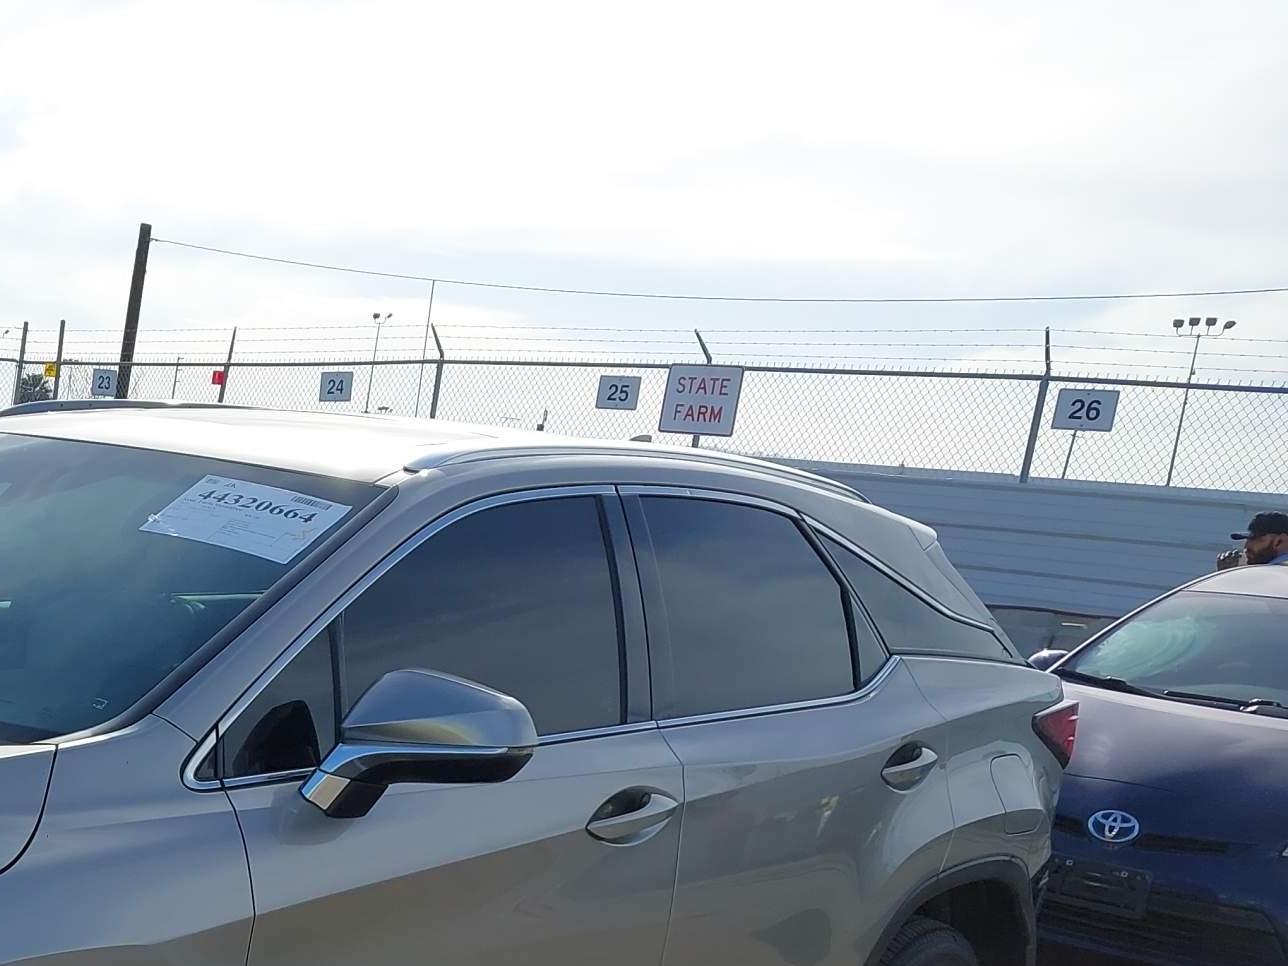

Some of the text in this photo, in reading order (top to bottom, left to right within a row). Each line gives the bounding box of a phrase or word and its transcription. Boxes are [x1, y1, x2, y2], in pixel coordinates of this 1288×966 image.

[97, 375, 111, 390] 23
[327, 379, 344, 395] 24
[676, 376, 731, 396] STATE
[607, 384, 630, 402] 25
[673, 403, 723, 423] FARM
[1068, 399, 1102, 421] 26
[197, 489, 318, 524] 44320664
